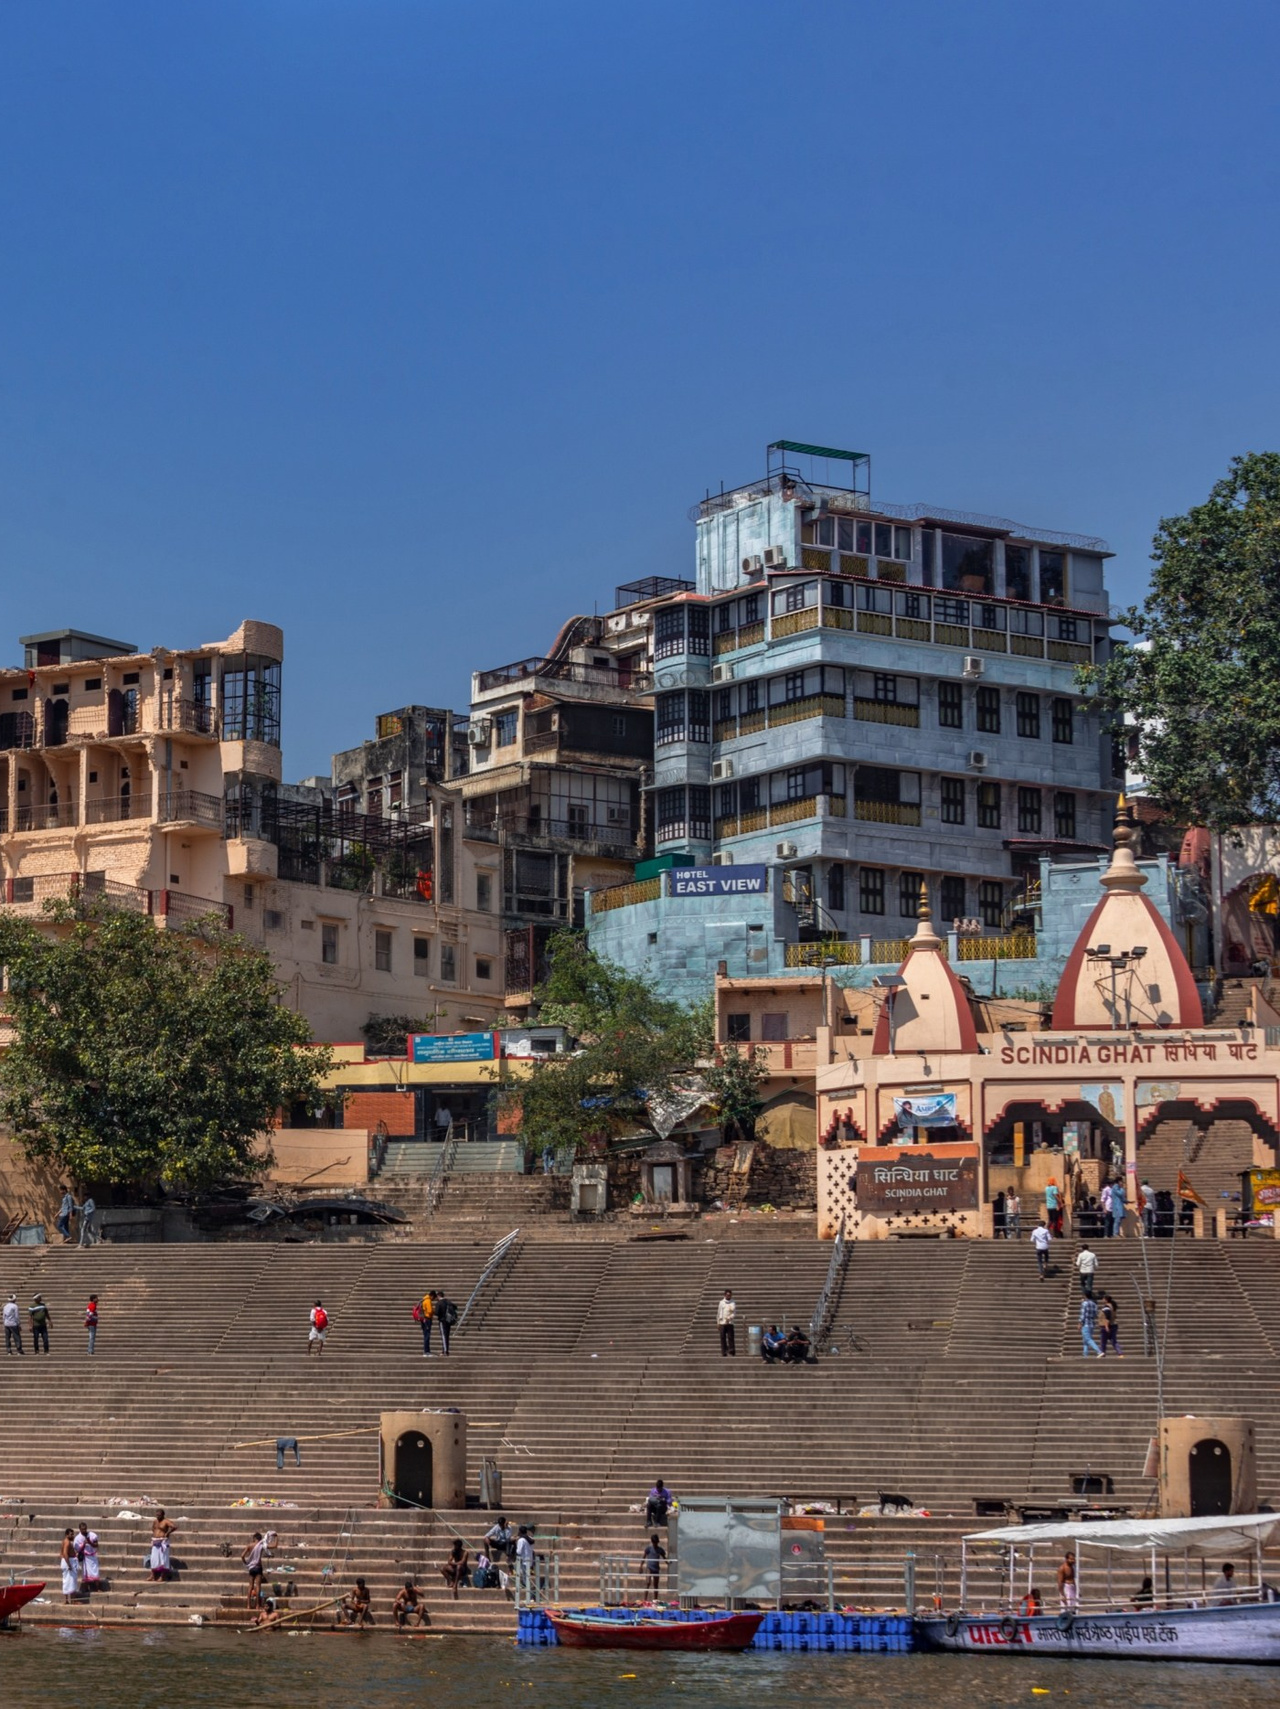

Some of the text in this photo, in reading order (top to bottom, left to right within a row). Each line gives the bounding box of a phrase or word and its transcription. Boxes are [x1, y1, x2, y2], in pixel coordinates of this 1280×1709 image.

[676, 870, 708, 879] HOTEL
[676, 879, 761, 893] EAST VIEW
[1001, 1045, 1155, 1064] SCINDIA GHAT
[1226, 1043, 1258, 1060] घाट
[874, 1166, 959, 1183] सिन्धिया घाट
[885, 1187, 948, 1198] SCINDIA GHAT
